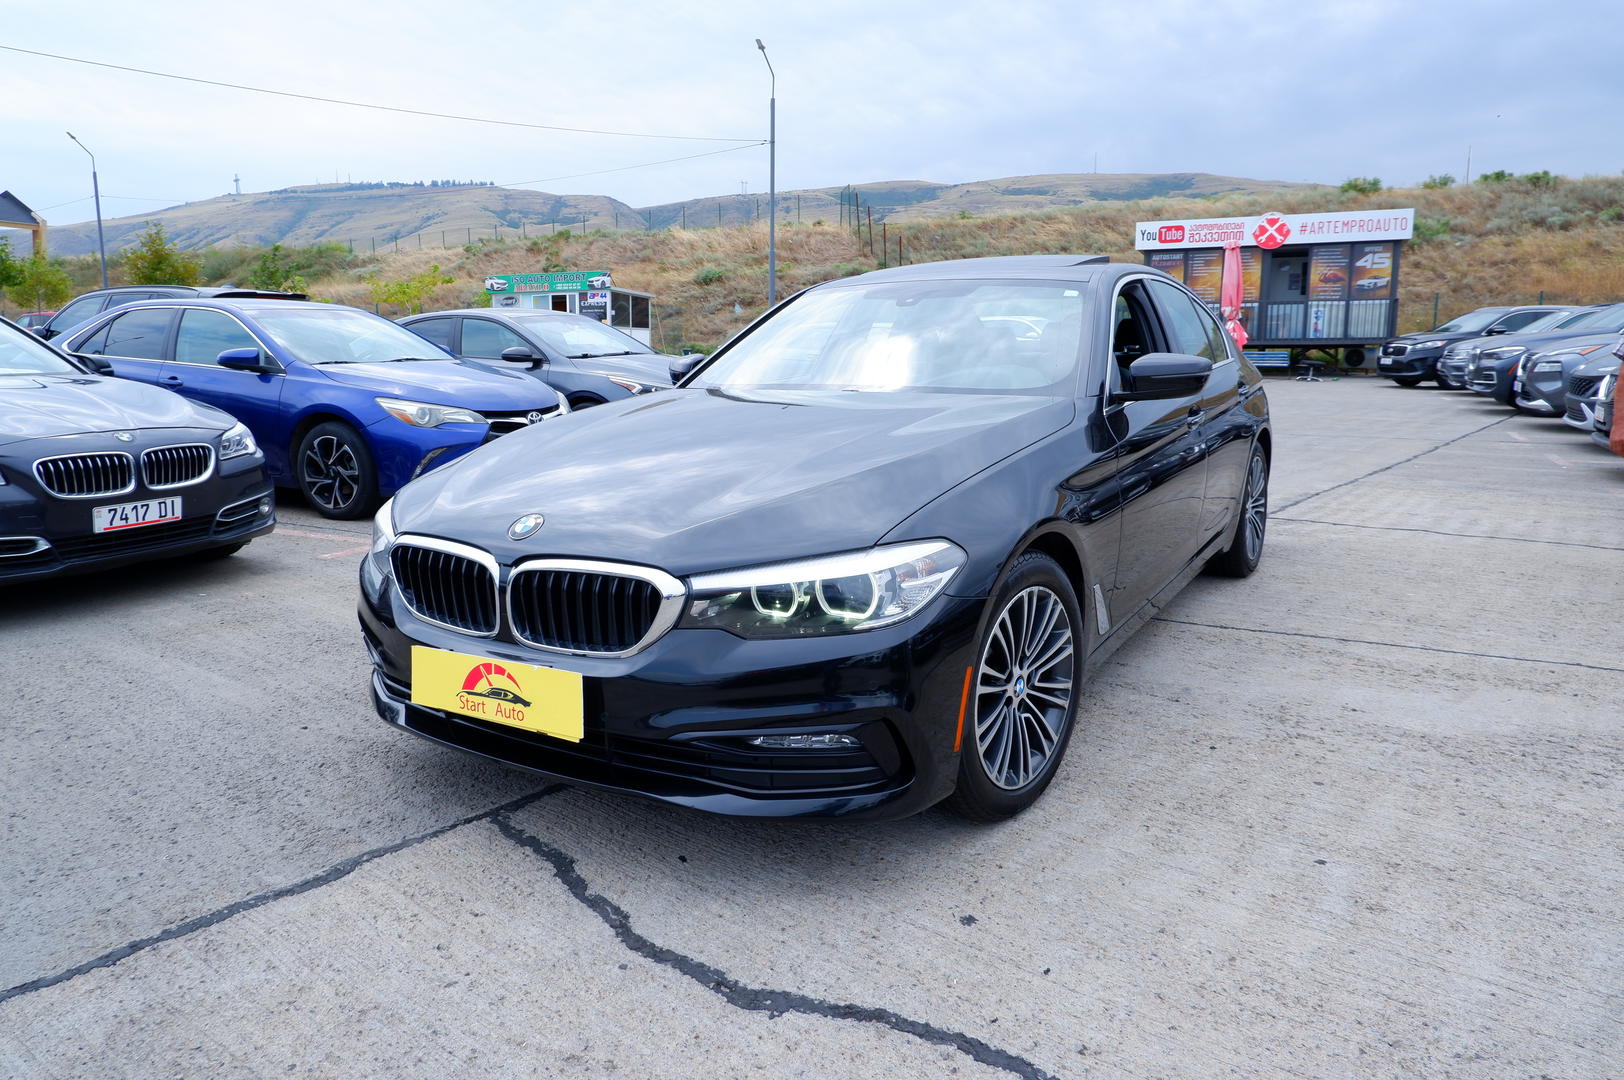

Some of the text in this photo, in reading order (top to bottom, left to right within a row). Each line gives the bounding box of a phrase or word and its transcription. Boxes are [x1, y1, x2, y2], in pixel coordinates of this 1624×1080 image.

[1300, 216, 1408, 235] #ARTEMPROAUTO
[1355, 252, 1392, 269] 45
[527, 274, 551, 283] AUTO
[553, 273, 587, 282] IMPORT
[108, 499, 175, 526] 7417 DI
[459, 695, 525, 721] Start Auto
